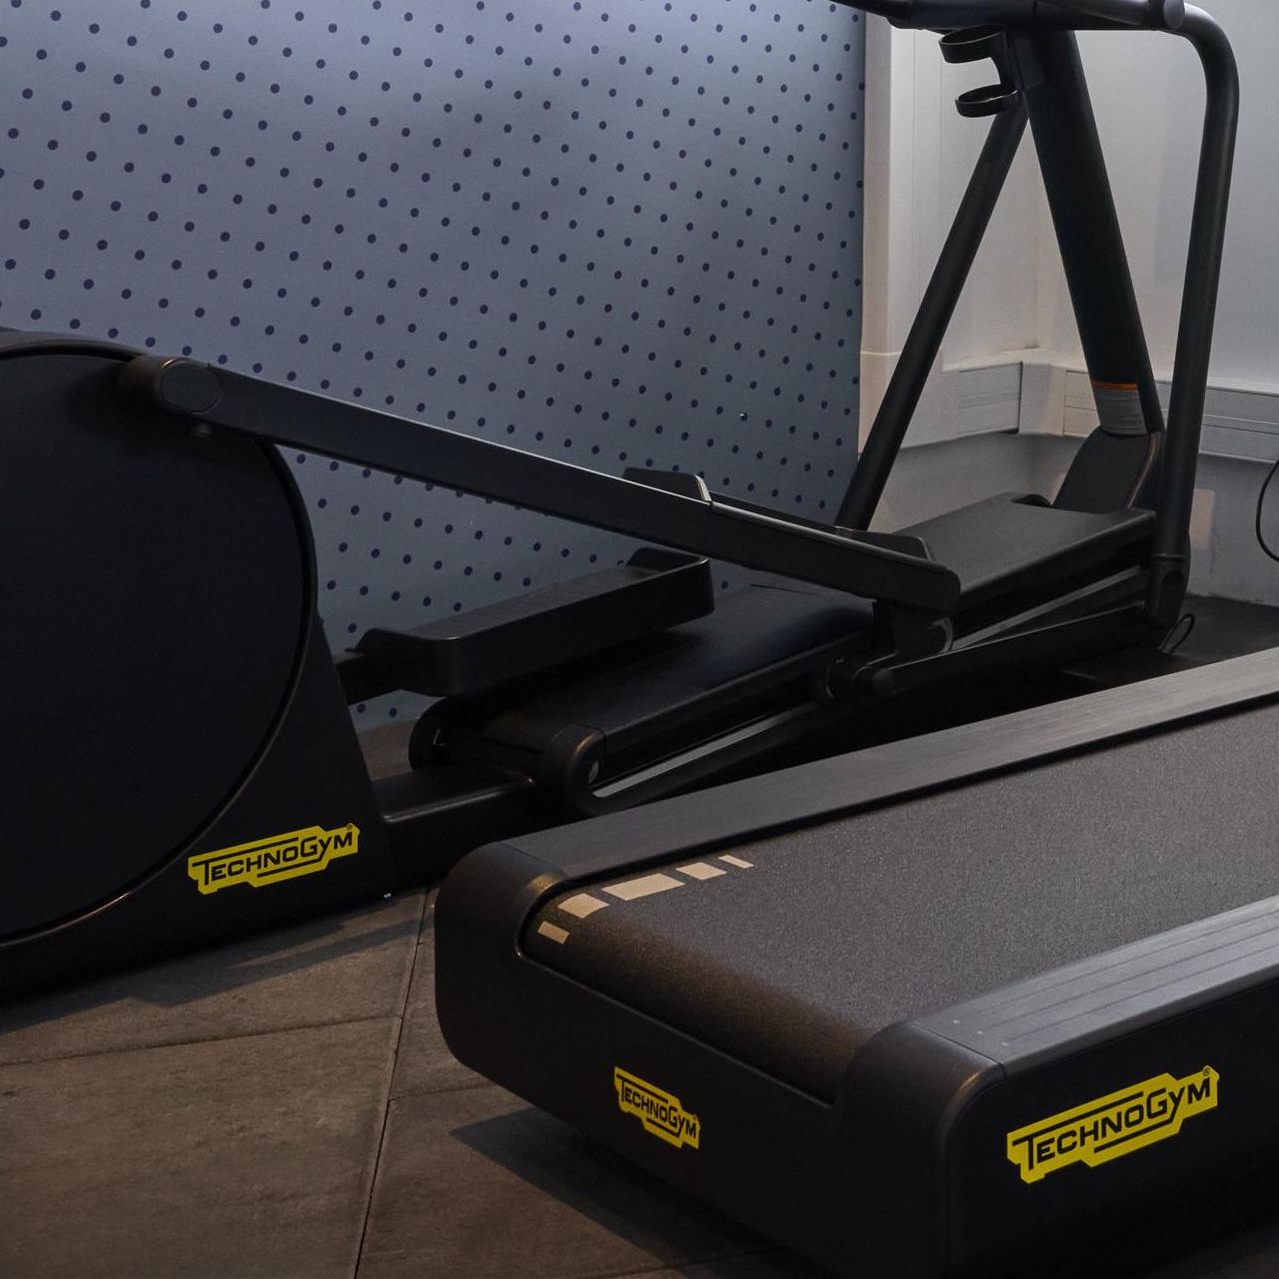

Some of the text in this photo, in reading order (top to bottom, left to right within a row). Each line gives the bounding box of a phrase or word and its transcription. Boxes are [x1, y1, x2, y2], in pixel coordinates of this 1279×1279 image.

[192, 830, 353, 886] TECHNOGYM
[615, 1073, 697, 1139] TECHNOGYM
[1011, 1076, 1211, 1172] TECHNOGYM
